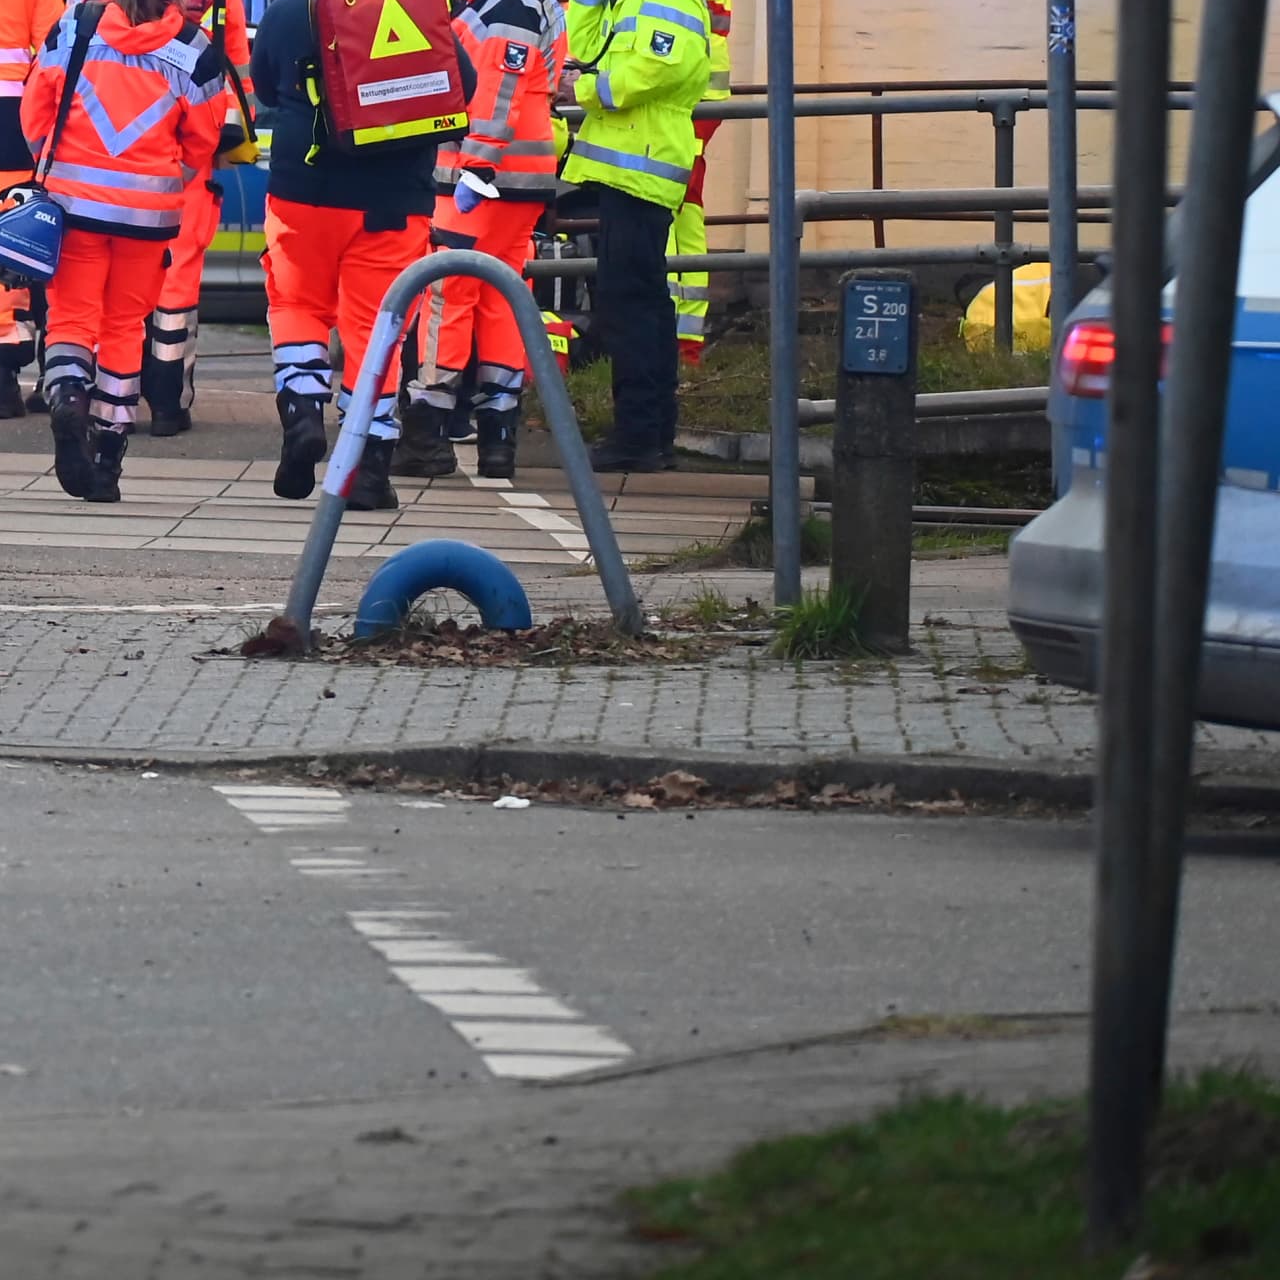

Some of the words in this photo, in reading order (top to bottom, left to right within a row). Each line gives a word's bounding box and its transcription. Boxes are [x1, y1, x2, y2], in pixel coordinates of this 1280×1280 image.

[434, 117, 457, 129] PAX
[34, 210, 57, 226] ZOLL
[882, 302, 907, 315] 200
